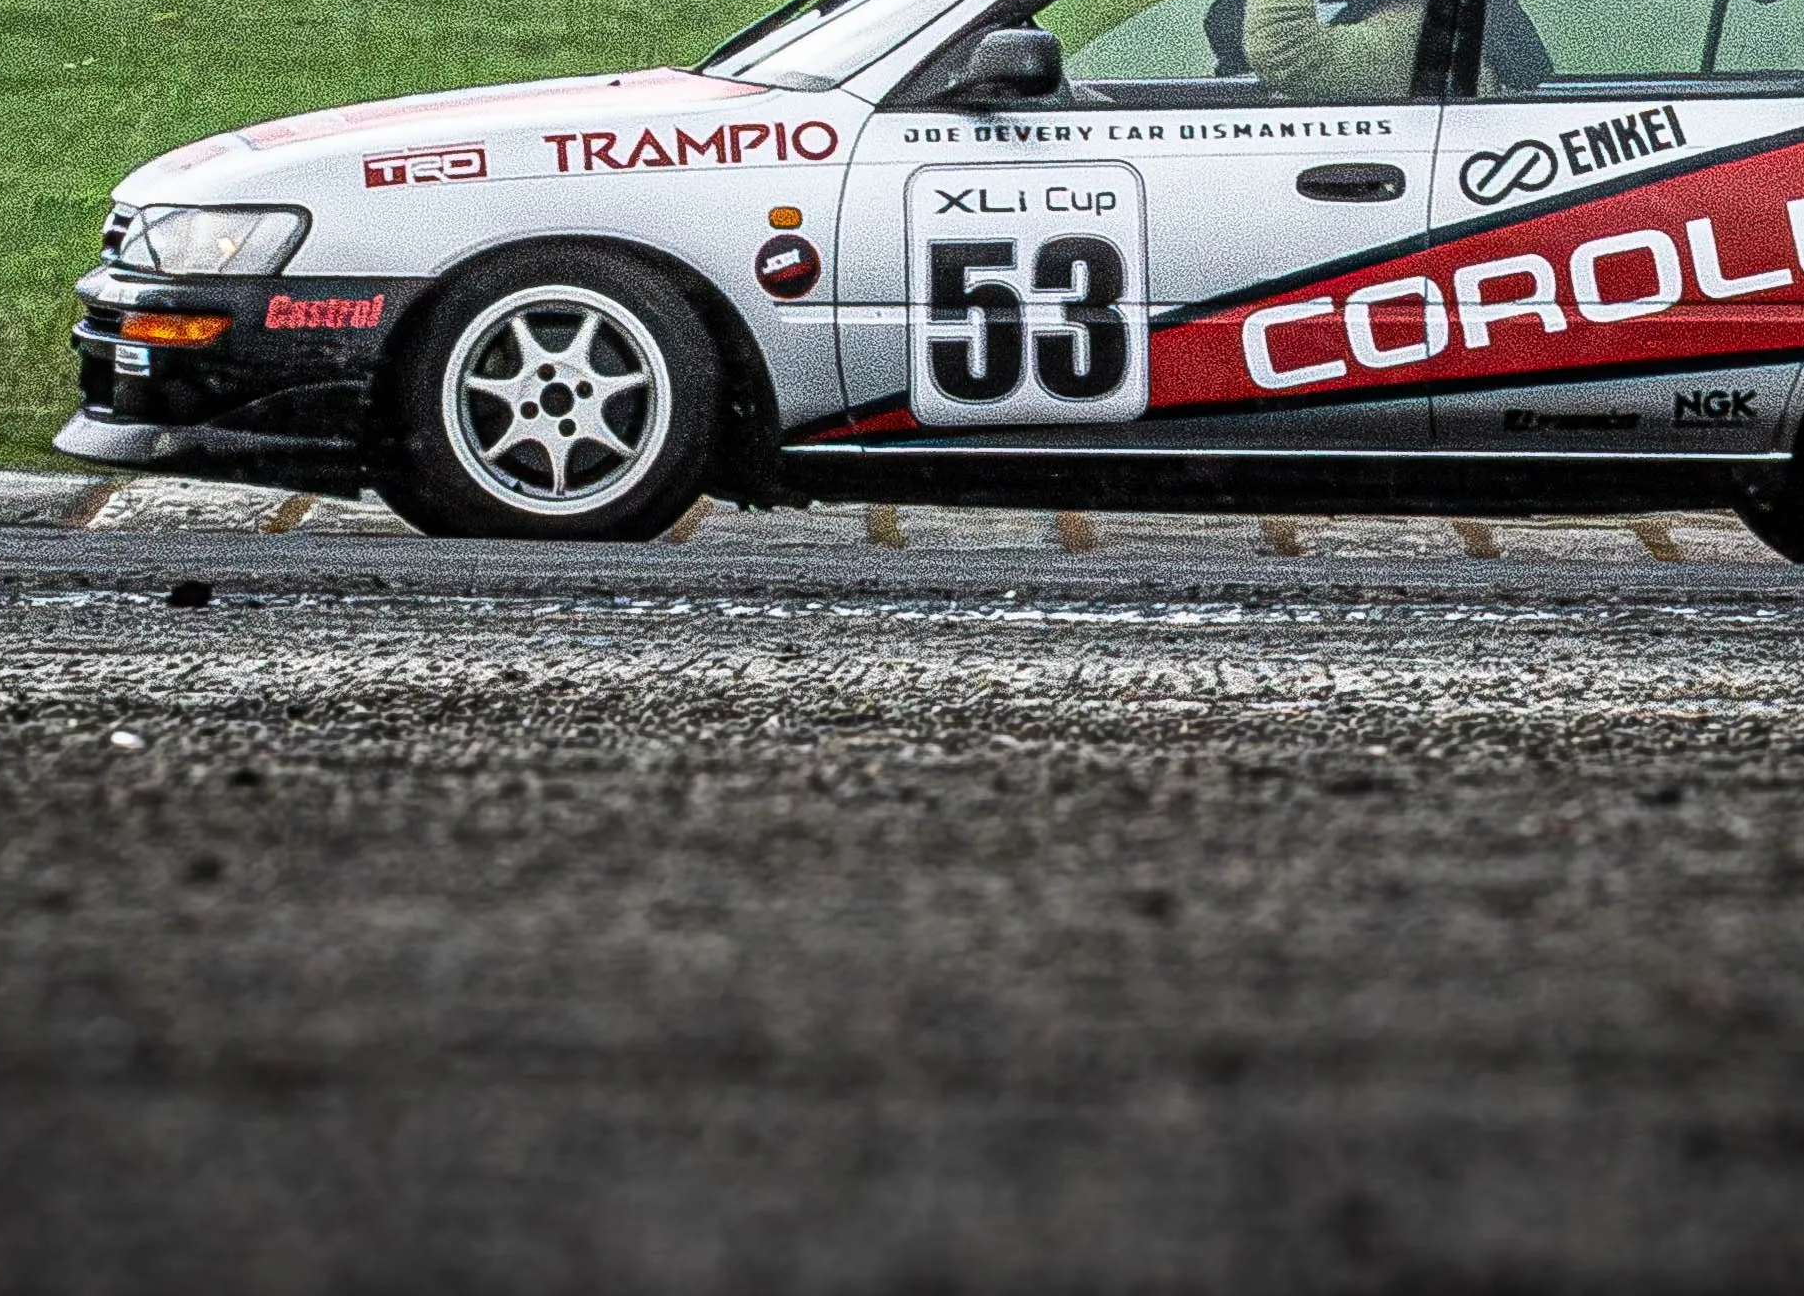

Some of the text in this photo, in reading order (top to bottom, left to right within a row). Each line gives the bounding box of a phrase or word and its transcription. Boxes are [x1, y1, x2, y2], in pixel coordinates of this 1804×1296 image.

[542, 119, 840, 174] TRAMPIO
[903, 119, 1393, 144] JOE DEVERY CAR DISMANTLERS
[1558, 104, 1687, 177] ENKEI
[1044, 185, 1117, 215] Cup
[264, 292, 386, 331] Castrol
[925, 231, 1132, 405] 53
[1674, 388, 1759, 419] NGK
